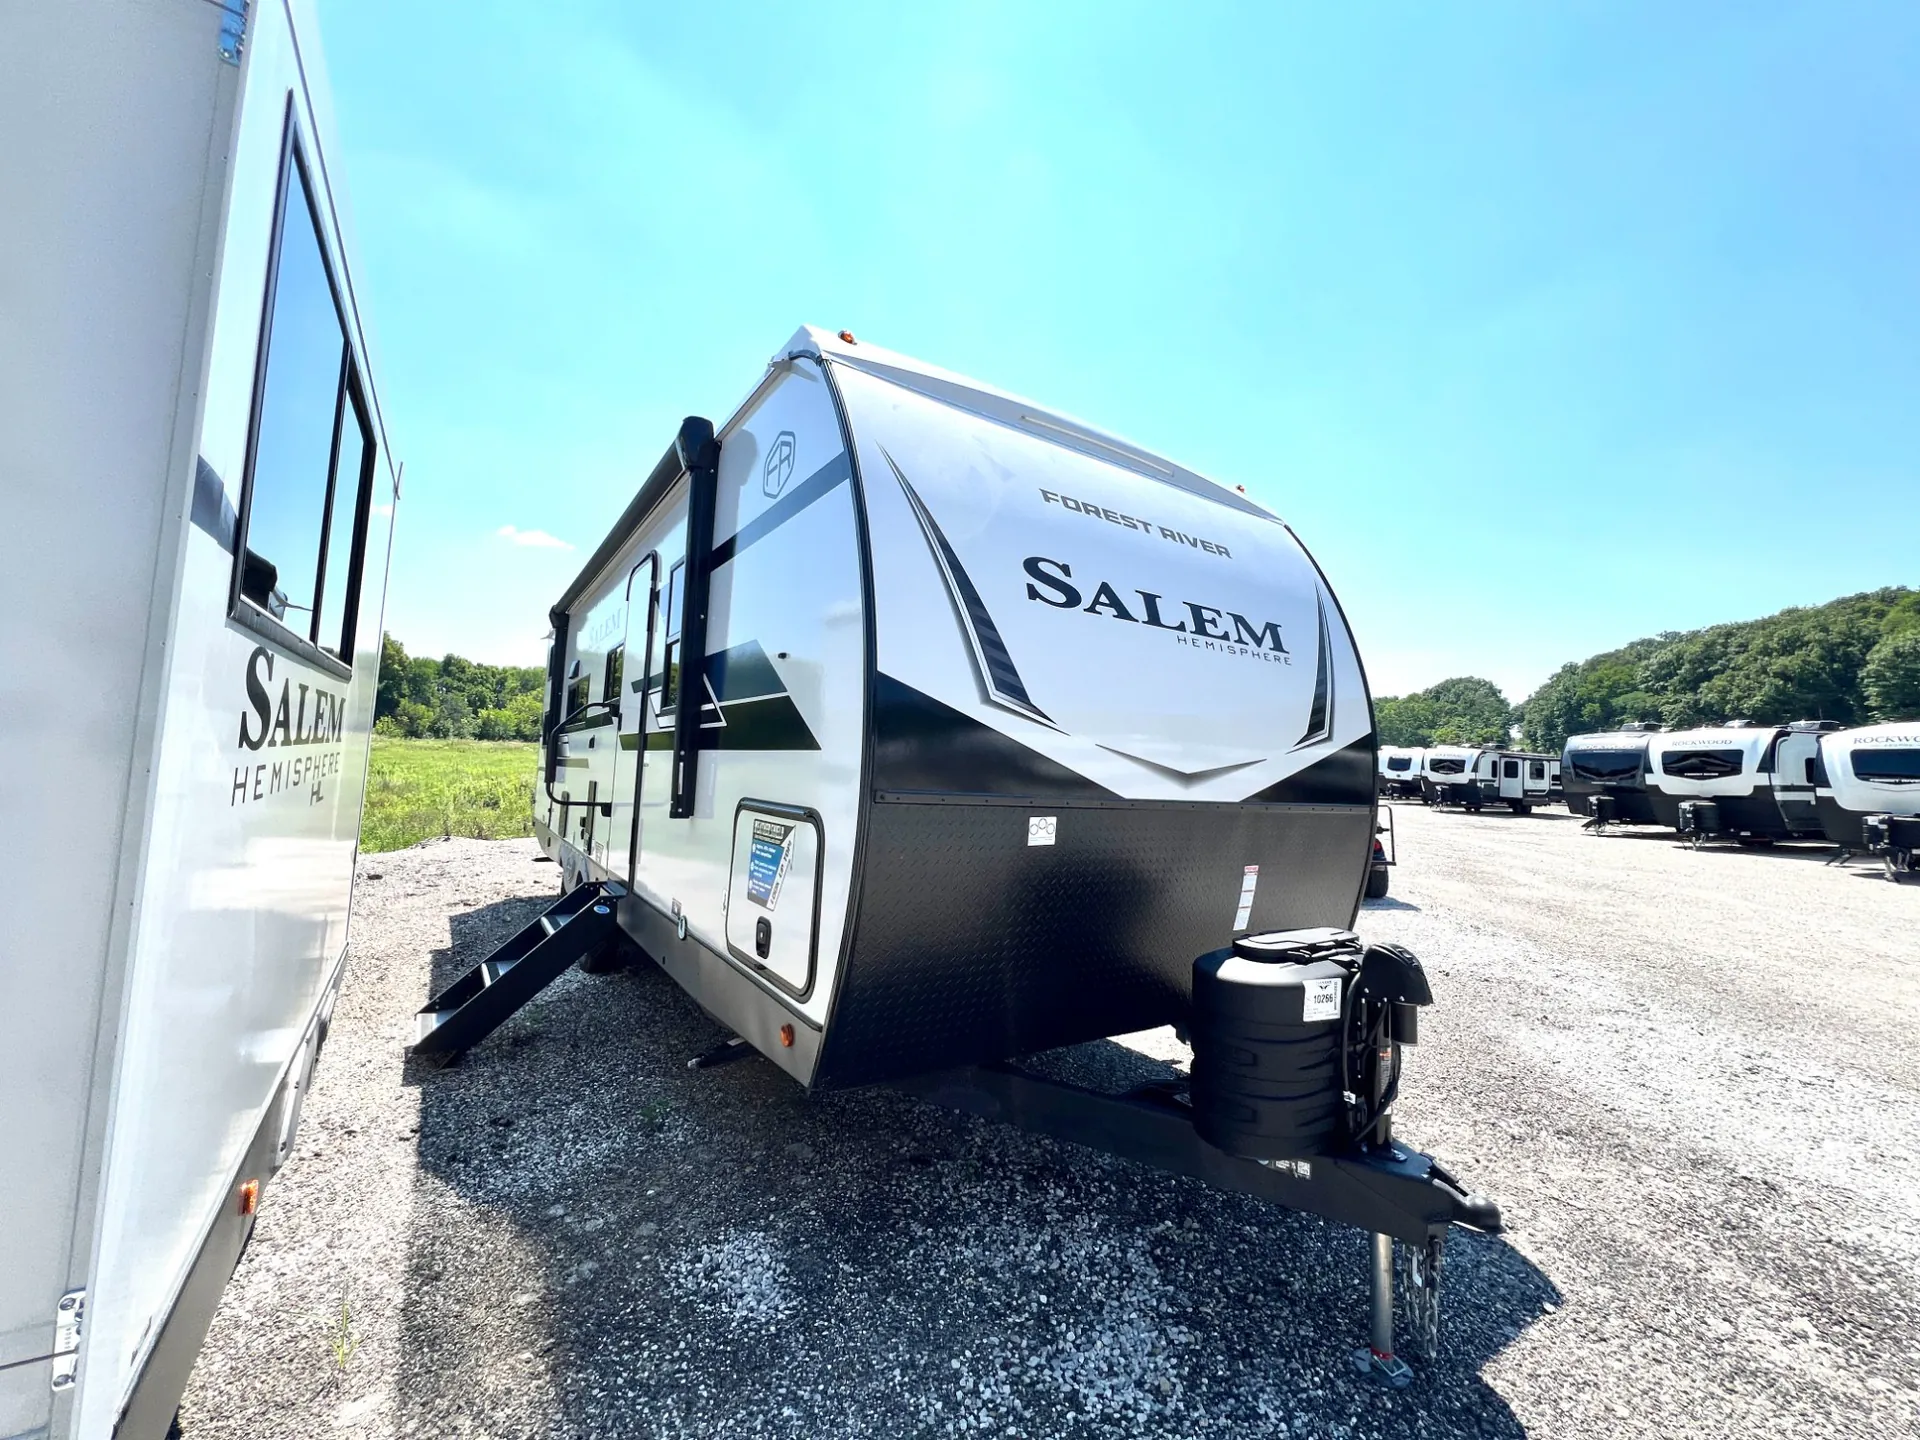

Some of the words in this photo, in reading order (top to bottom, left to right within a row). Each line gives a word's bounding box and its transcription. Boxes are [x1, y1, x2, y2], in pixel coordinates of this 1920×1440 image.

[1039, 488, 1152, 534] FOREST
[1158, 526, 1232, 559] RIVER
[1023, 556, 1290, 654] SALEM
[1177, 635, 1291, 666] HEMISPHERE
[238, 647, 346, 751] SALEM
[1672, 739, 1733, 747] ROCKWOOD
[231, 752, 341, 807] HEMISPHERE
